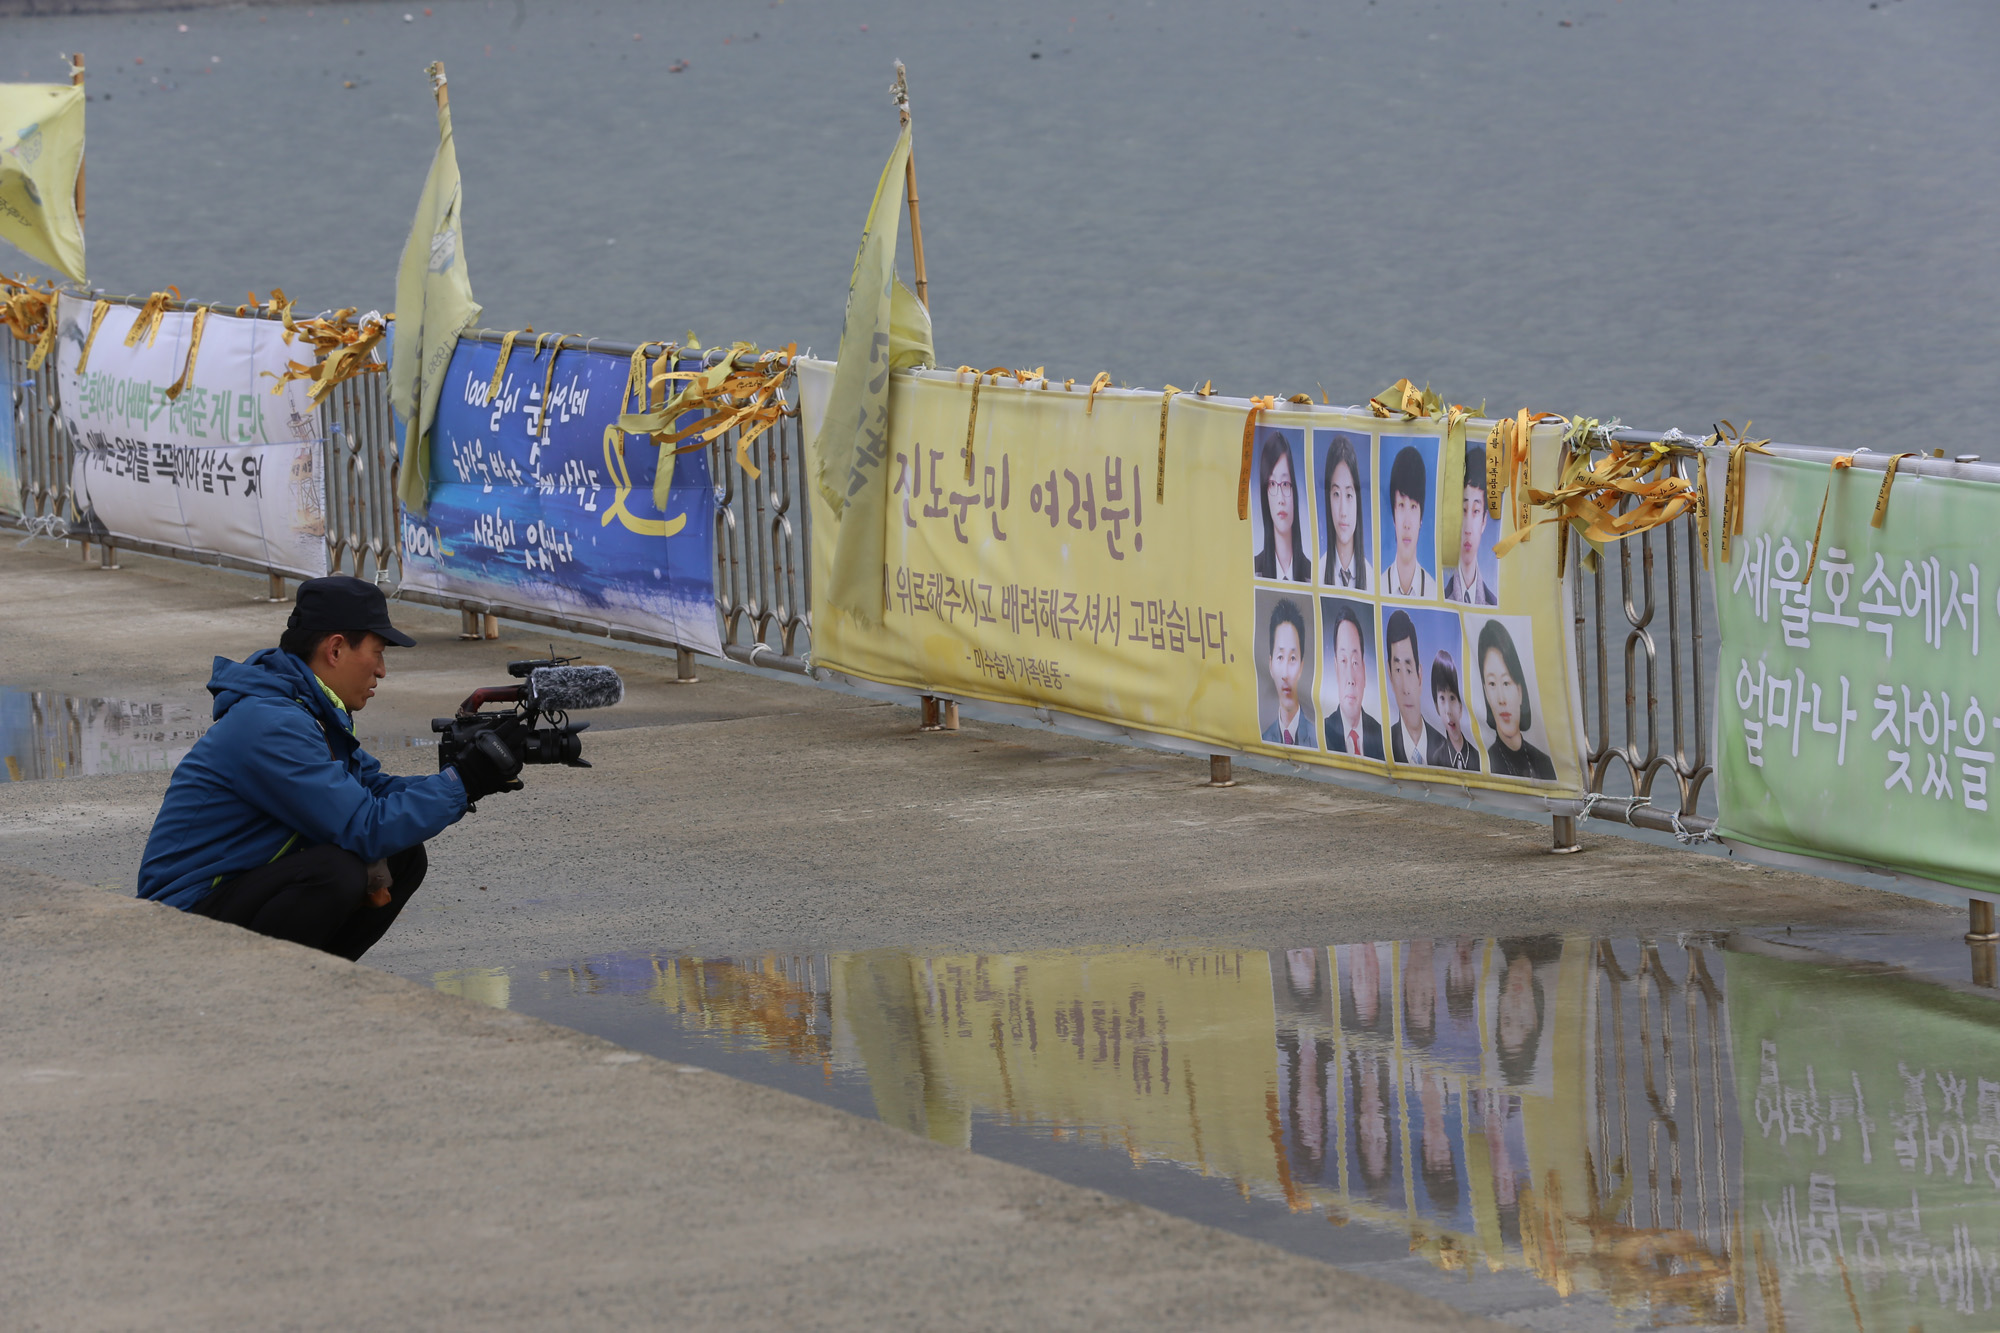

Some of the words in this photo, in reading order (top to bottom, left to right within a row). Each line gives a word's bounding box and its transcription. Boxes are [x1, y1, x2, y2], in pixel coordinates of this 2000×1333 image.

[525, 519, 573, 573] 있니다
[893, 442, 1010, 544] 진도군민
[1029, 455, 1143, 561] 여러분!
[896, 565, 997, 628] 위로해주시고
[1001, 584, 1121, 647] 배려해주셔서
[1128, 598, 1235, 665] 고맙습니다.
[1735, 657, 1858, 768] 얼마나
[1871, 682, 2000, 812] 찾았을
